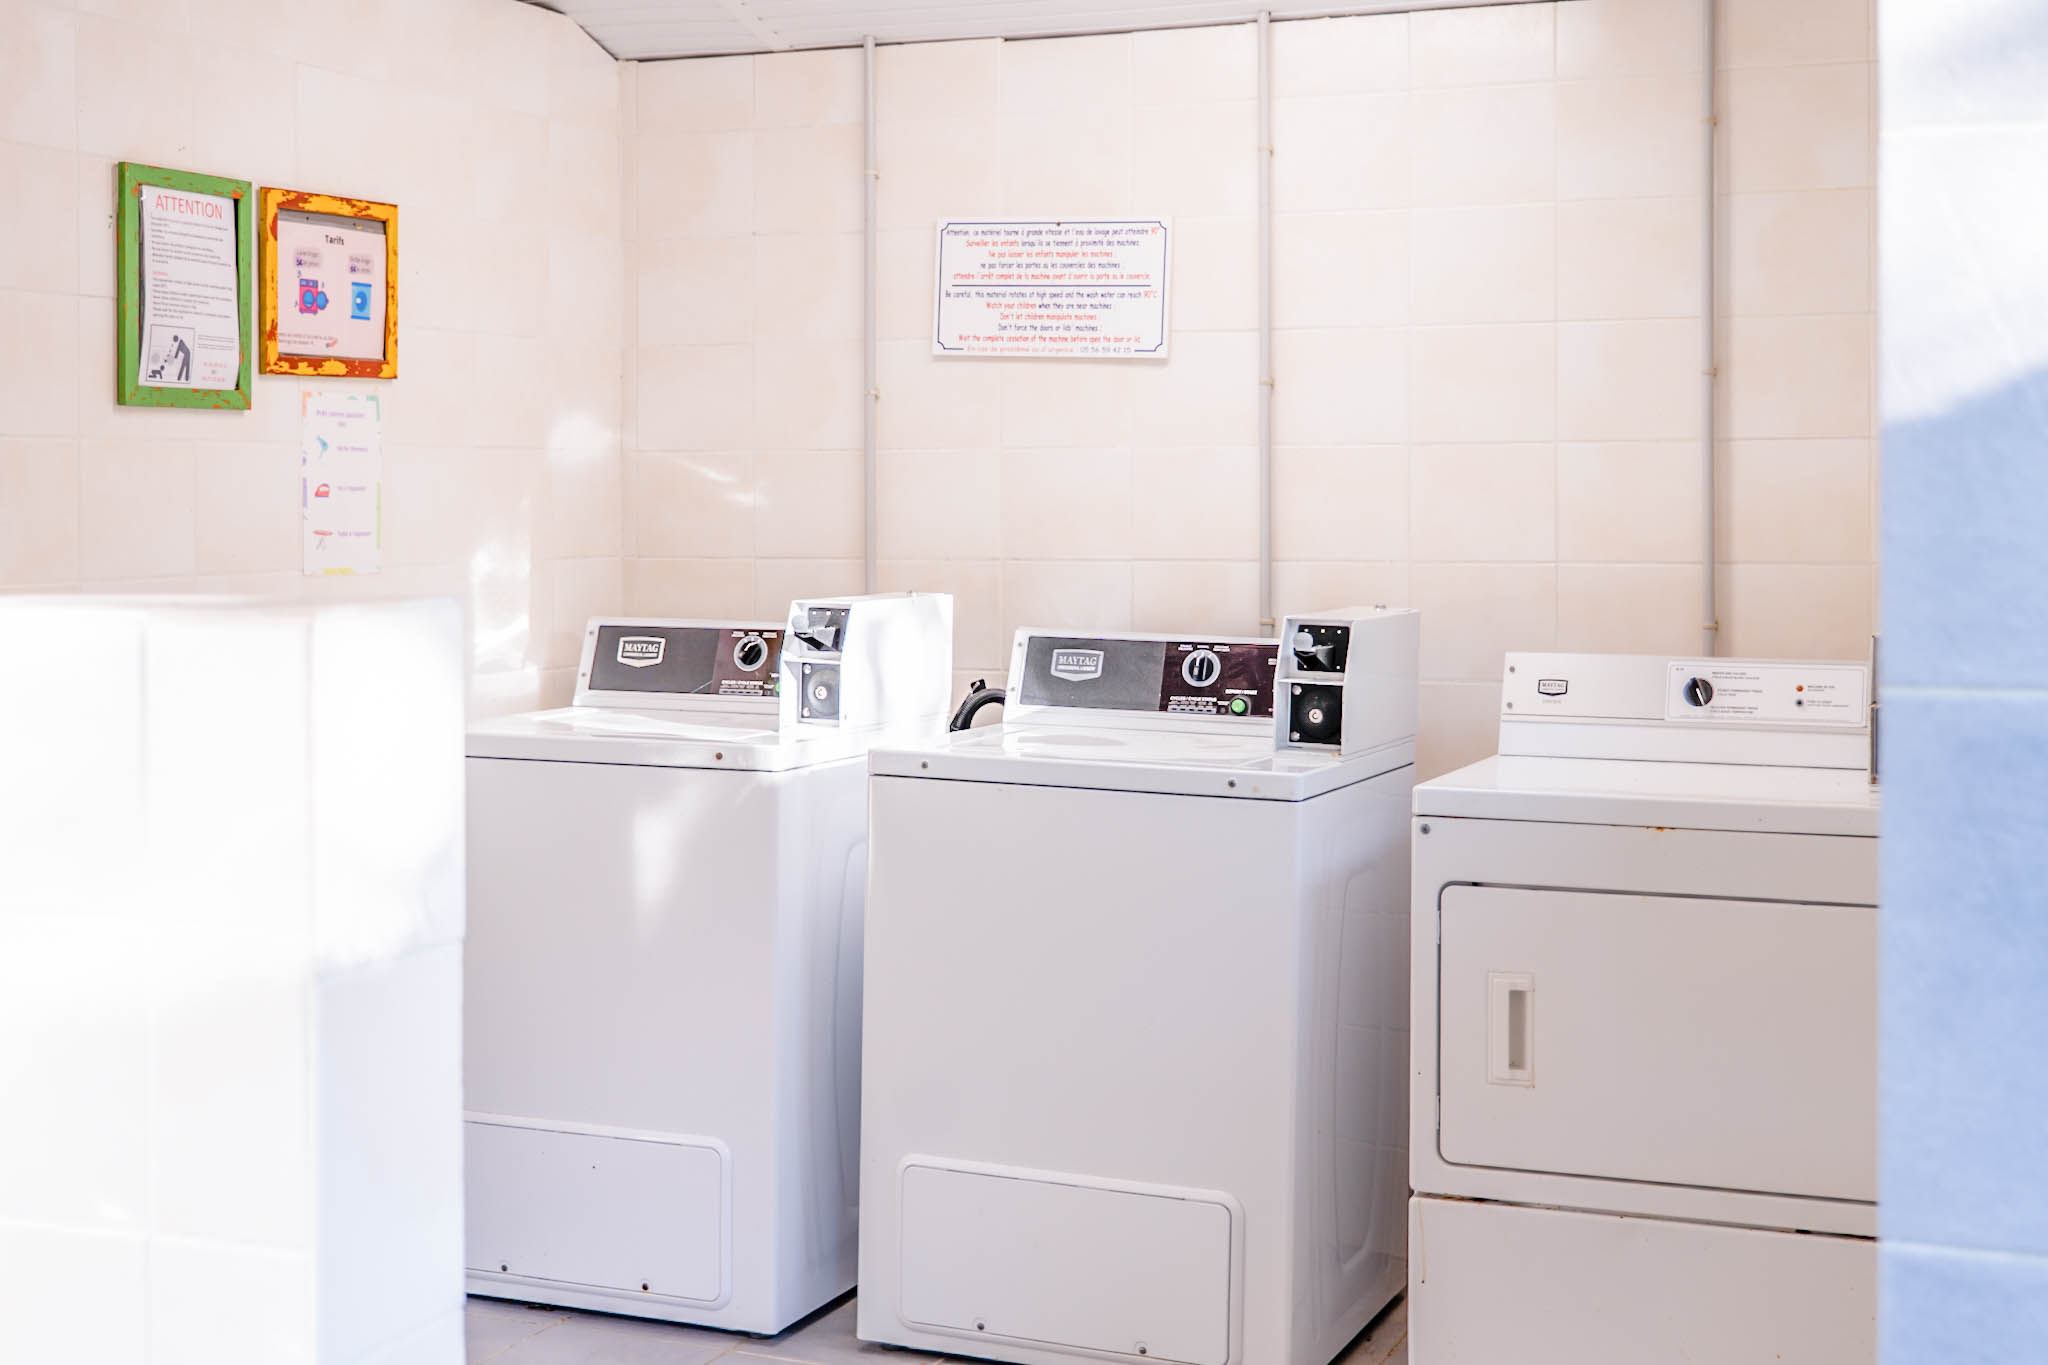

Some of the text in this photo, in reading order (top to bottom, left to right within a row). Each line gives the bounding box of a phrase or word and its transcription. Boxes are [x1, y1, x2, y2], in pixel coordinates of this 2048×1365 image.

[155, 194, 223, 219] ATTENTION
[325, 235, 345, 246] Tarifs
[624, 643, 659, 652] MAYTAG
[1058, 655, 1097, 665] MAYTAG
